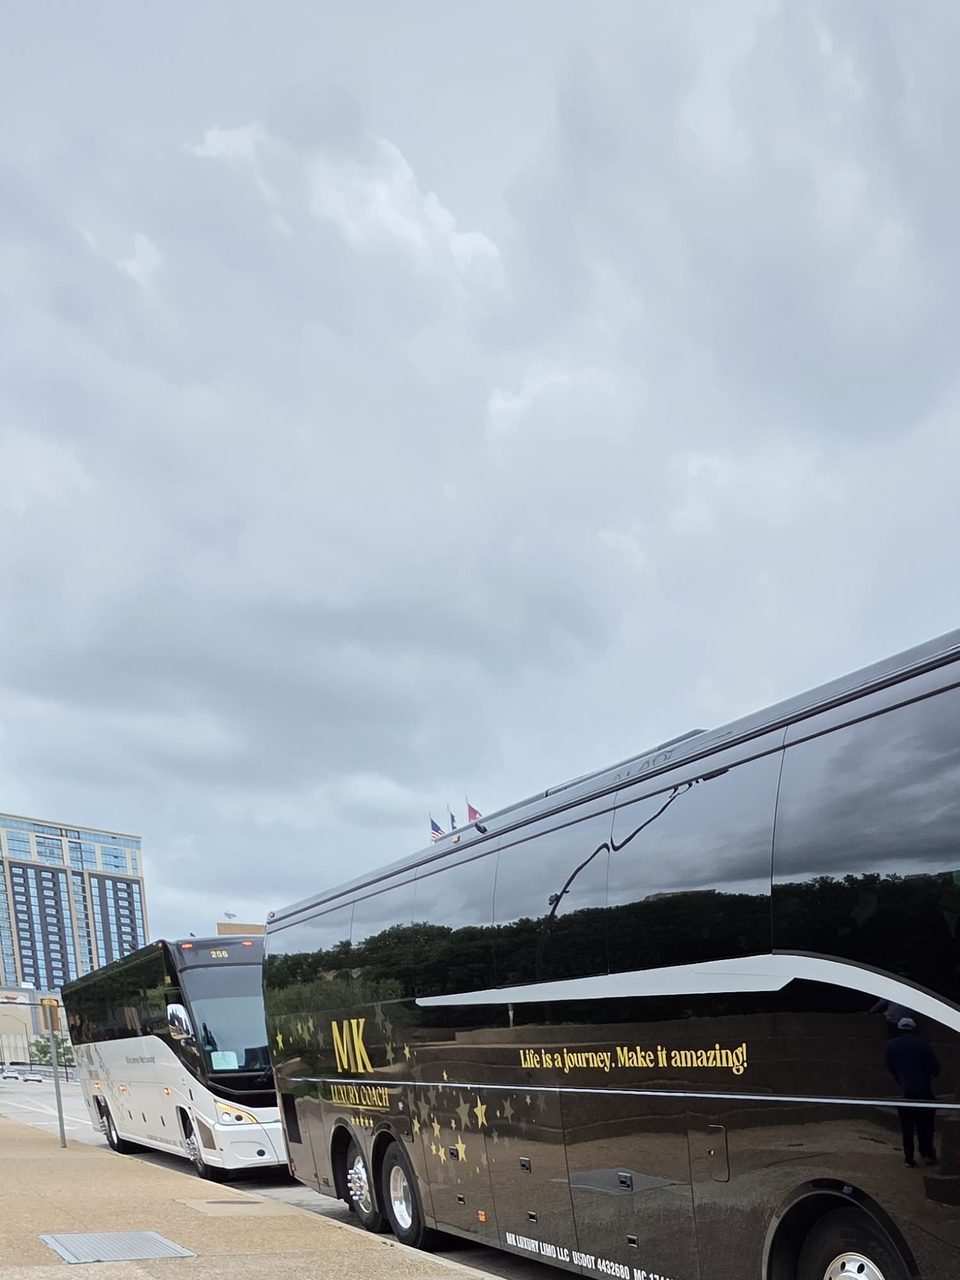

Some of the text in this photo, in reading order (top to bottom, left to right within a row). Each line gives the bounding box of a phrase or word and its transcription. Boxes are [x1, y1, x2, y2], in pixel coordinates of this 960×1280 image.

[331, 1018, 374, 1073] MK
[519, 1043, 748, 1075] Life is a journey. Make it amazing!
[330, 1084, 389, 1107] LUXURY COACH
[505, 1231, 517, 1247] MK
[516, 1234, 539, 1253] LUXURY
[539, 1241, 557, 1258] LIMO
[556, 1246, 570, 1262] LLC
[571, 1250, 596, 1270] USDOT
[597, 1258, 631, 1280] 4432680
